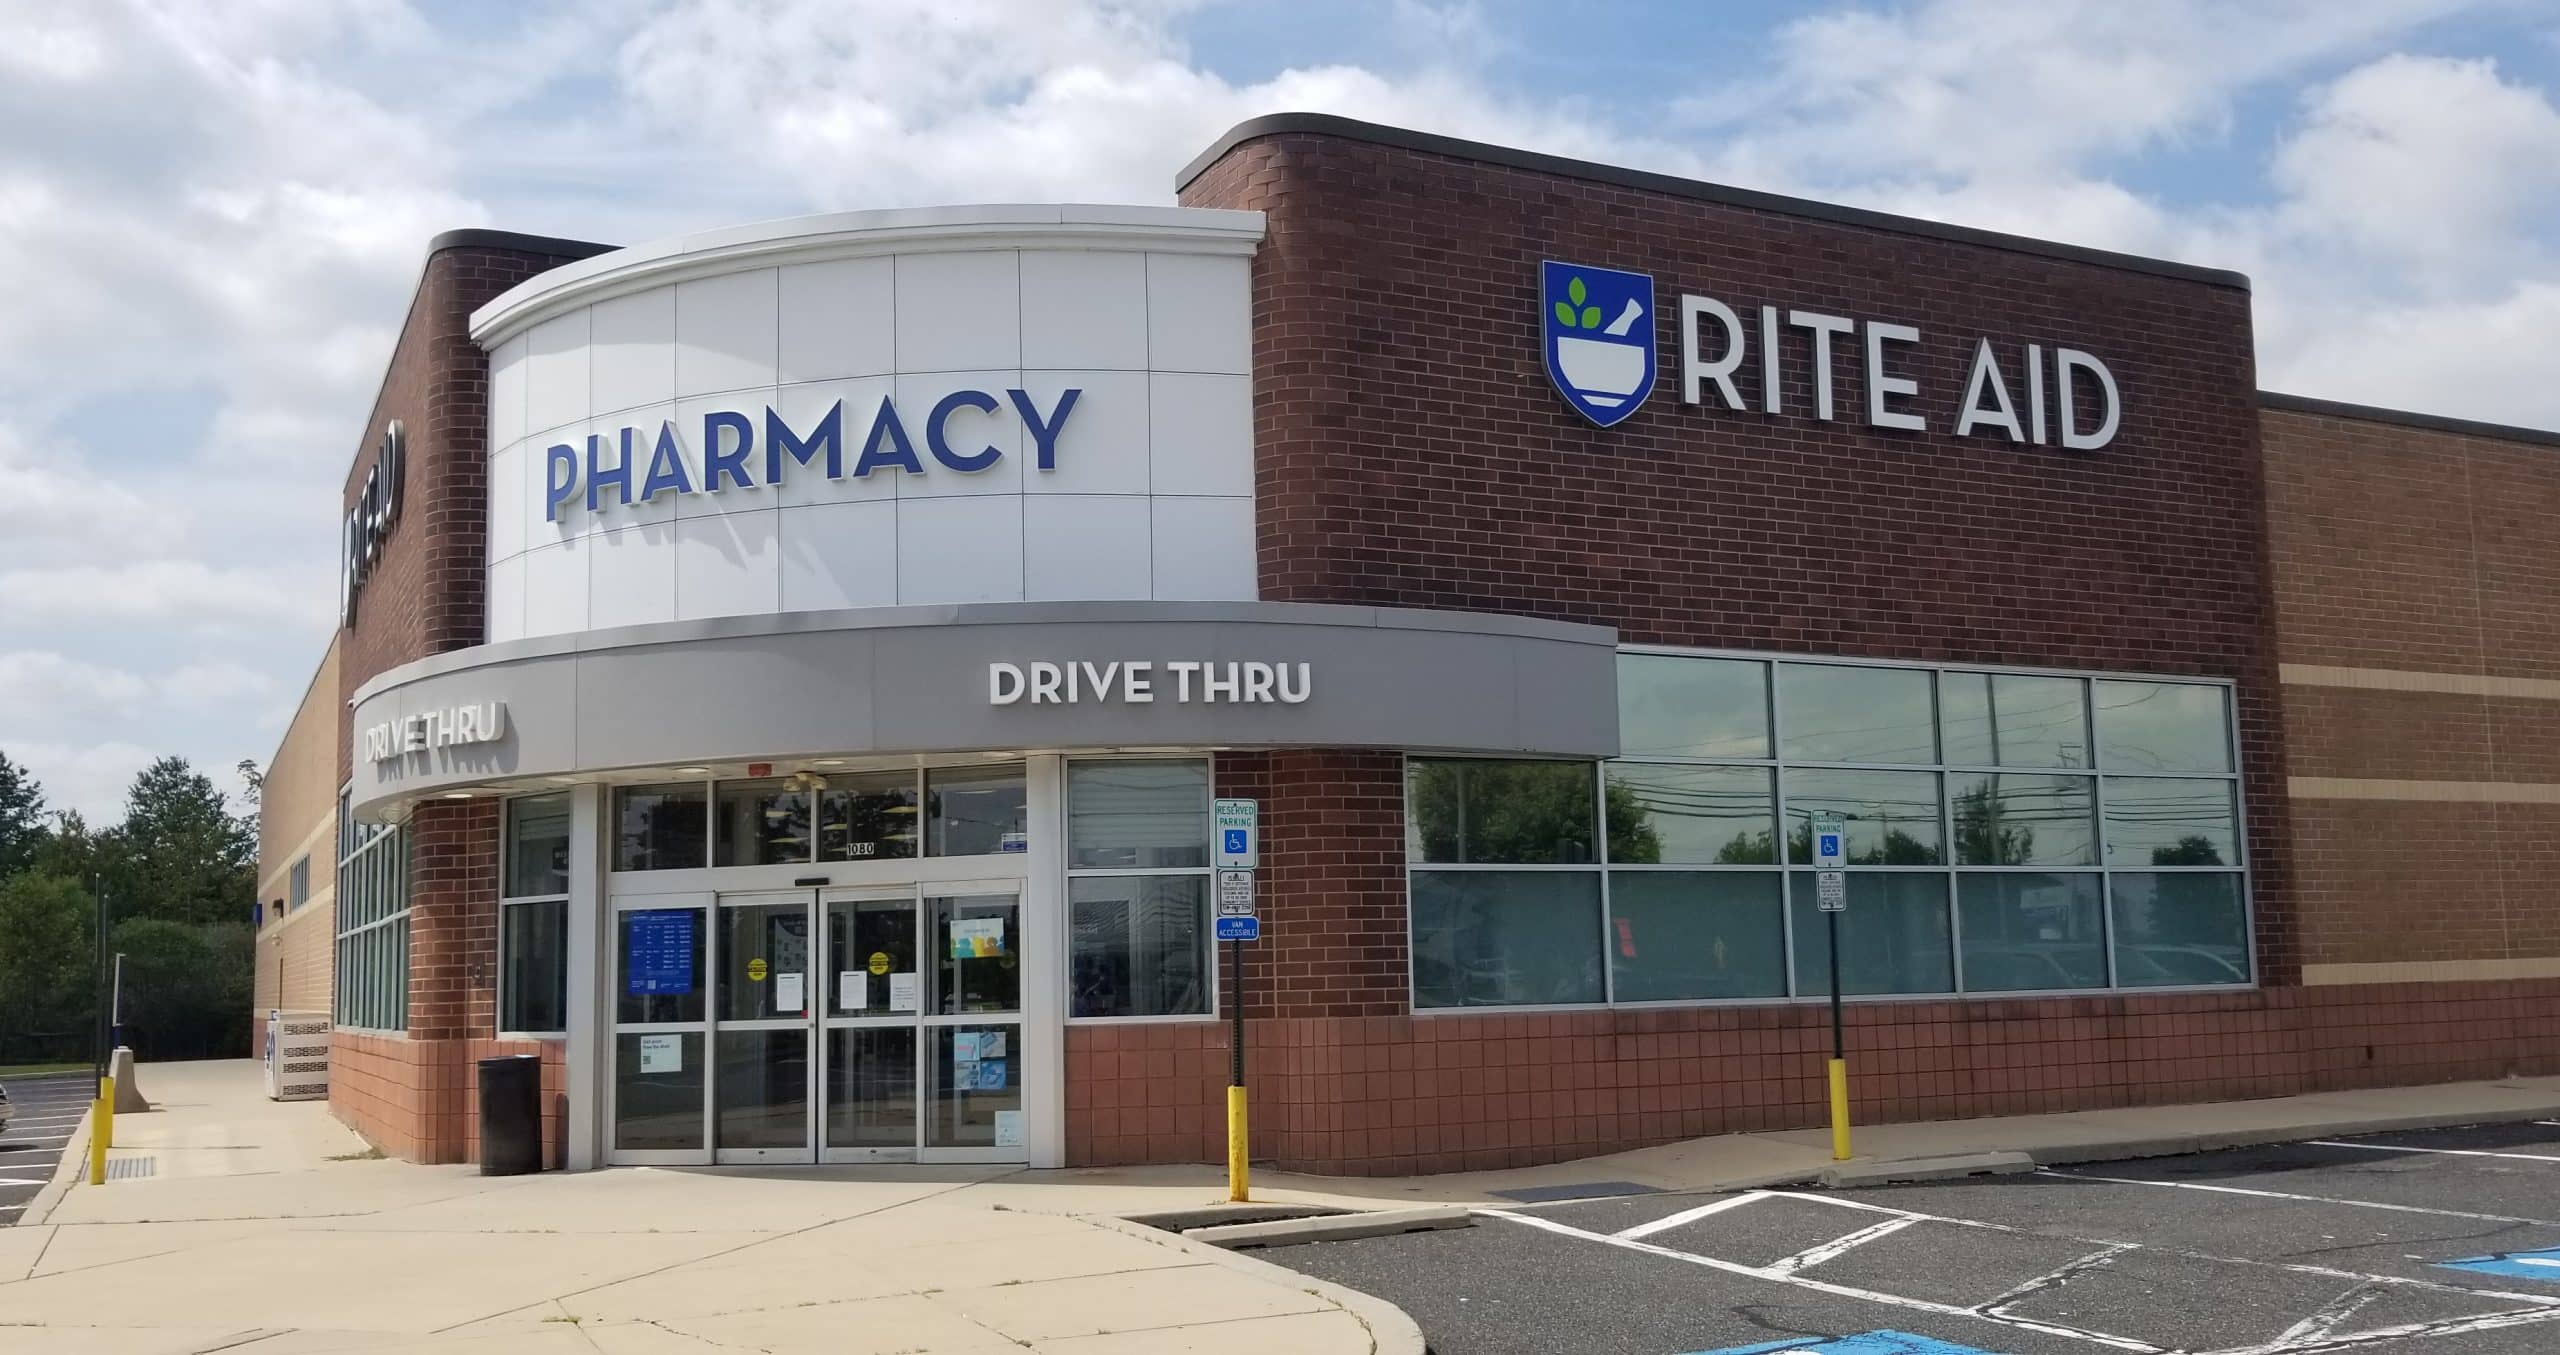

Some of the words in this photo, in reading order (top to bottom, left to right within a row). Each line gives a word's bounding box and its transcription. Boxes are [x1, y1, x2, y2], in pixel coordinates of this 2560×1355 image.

[1680, 294, 1926, 430] RITE
[1952, 336, 2121, 450] AID
[546, 388, 1083, 522] PHARMACY
[989, 660, 1154, 705] DRIVE
[1167, 660, 1311, 704] THRU
[366, 714, 425, 763] DRIVE
[423, 702, 506, 750] THRU
[1217, 806, 1254, 816] RESERVED
[1219, 818, 1252, 827] PARKING
[848, 843, 873, 855] 1080
[1231, 920, 1244, 929] VAN
[1219, 928, 1257, 937] ACCESSIBLE
